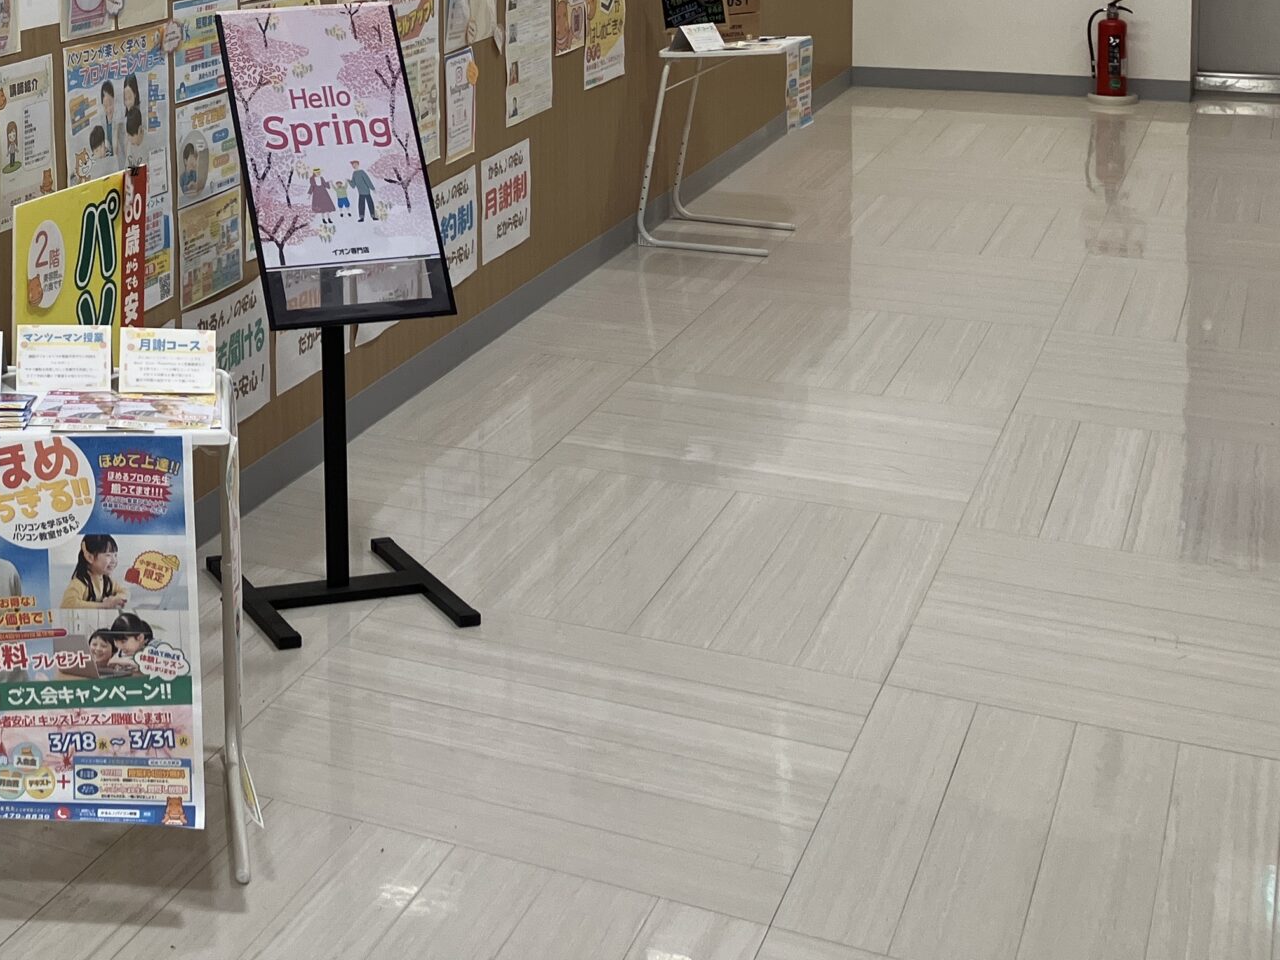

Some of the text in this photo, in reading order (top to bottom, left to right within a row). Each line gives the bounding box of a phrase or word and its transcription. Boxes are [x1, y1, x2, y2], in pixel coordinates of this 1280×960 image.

[68, 36, 147, 67] パソコンが楽しく学べる
[9, 78, 38, 98] 講師紹介
[289, 85, 351, 110] Hello
[263, 113, 392, 154] Spring
[485, 170, 527, 221] 月謝制
[439, 199, 473, 247] 約制
[35, 230, 61, 270] 2階
[332, 246, 370, 257] イオン専門店
[22, 332, 105, 345] マンツーマン授業
[138, 338, 202, 353] 月謝コース
[99, 453, 181, 475] ほめて上達!!
[107, 471, 172, 487] ほめるプロの先生
[15, 513, 76, 533] パソコンを学ぶなら
[143, 567, 165, 584] 限定
[32, 652, 91, 669] プレゼント
[49, 732, 96, 753] 3/18
[129, 728, 176, 750] 3/31
